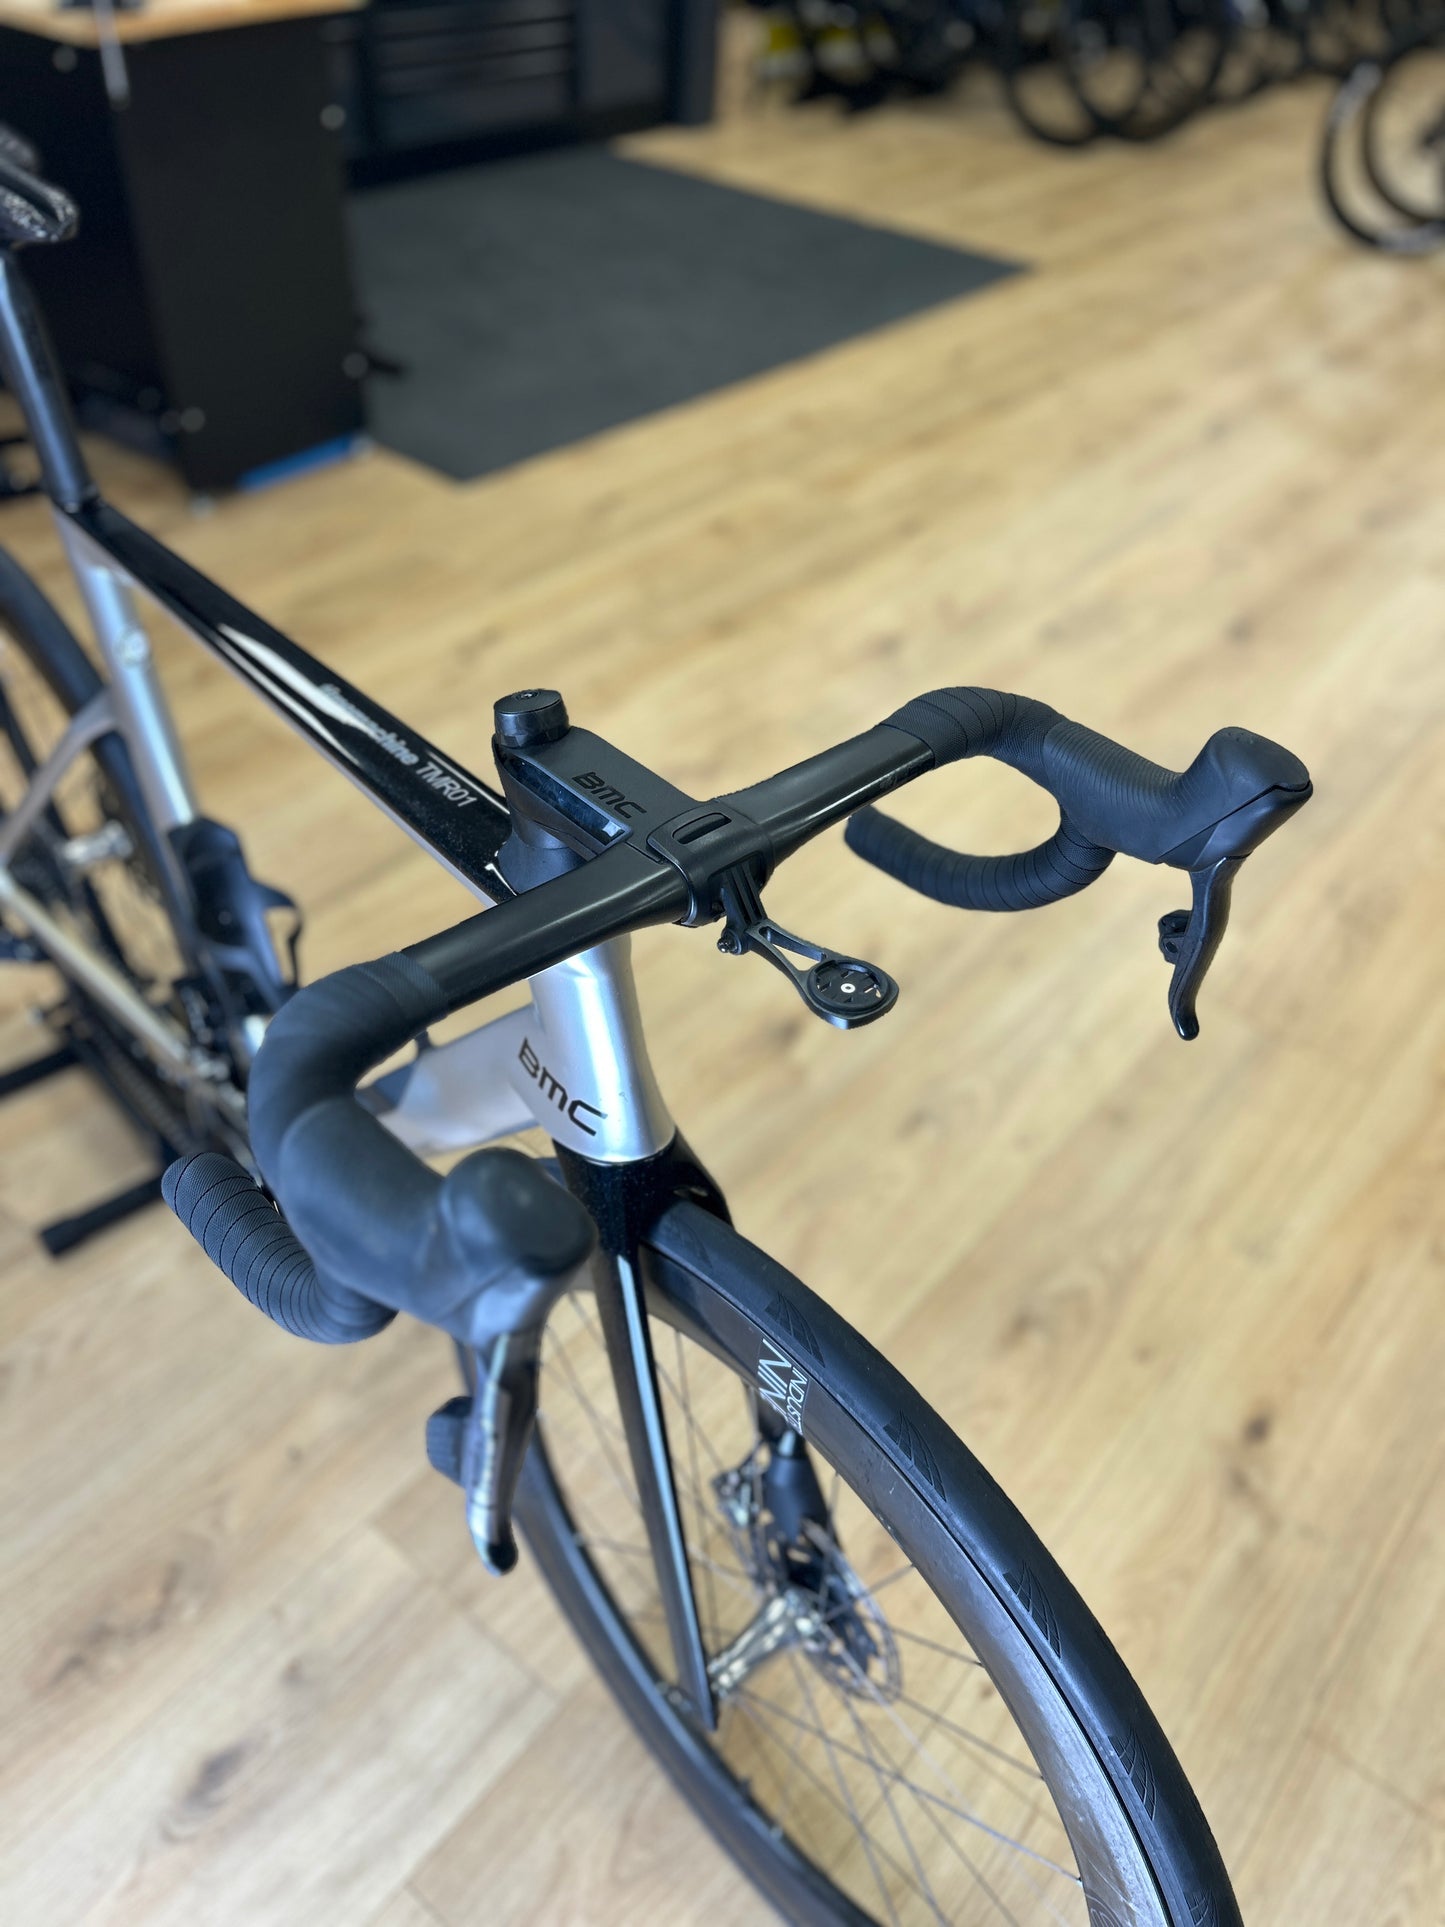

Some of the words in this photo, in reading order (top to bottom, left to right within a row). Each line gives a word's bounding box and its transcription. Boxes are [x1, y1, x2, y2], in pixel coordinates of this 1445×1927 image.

[416, 761, 478, 807] TMR01
[572, 771, 647, 819] BMC
[518, 1036, 608, 1137] BMC
